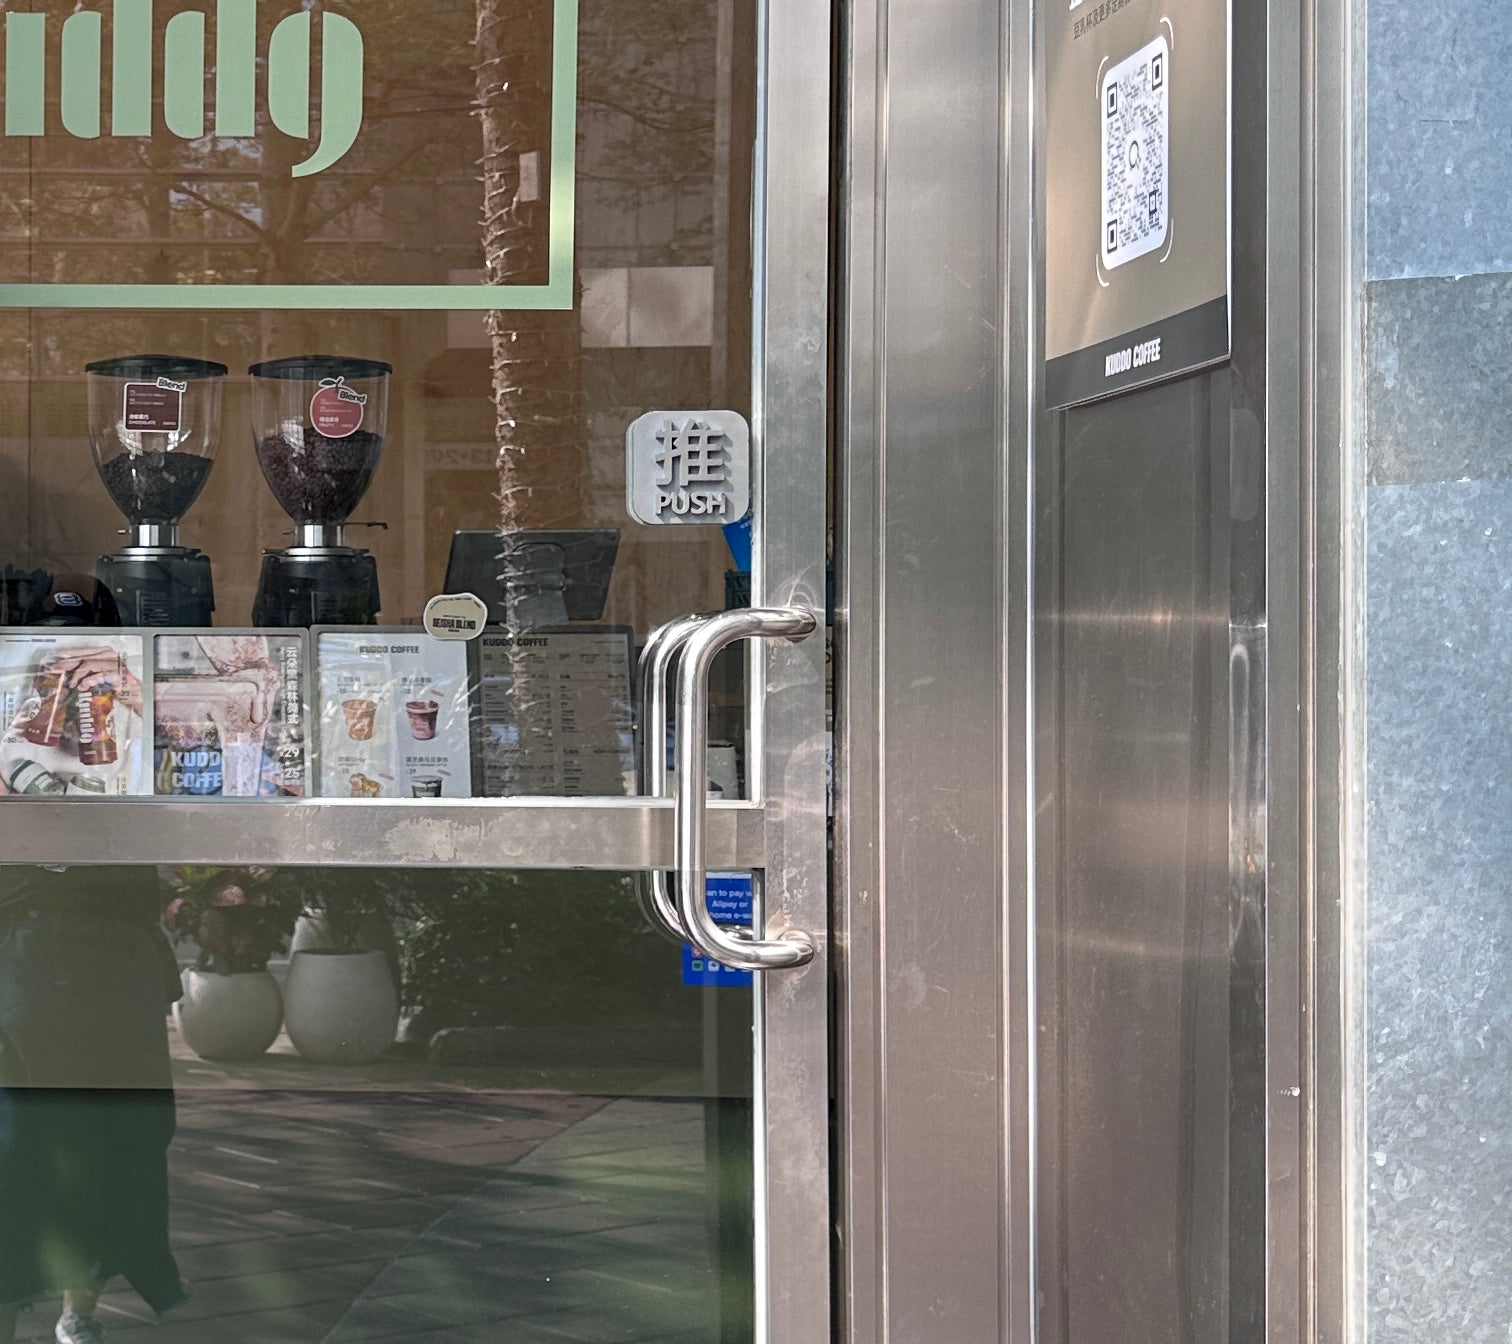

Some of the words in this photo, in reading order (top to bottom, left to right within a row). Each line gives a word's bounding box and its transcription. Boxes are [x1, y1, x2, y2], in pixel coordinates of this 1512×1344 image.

[1105, 348, 1132, 377] KUDDO
[1133, 337, 1161, 368] COFFEE
[655, 418, 727, 487] 推
[656, 492, 727, 516] PUSH
[390, 645, 420, 654] COFFEE
[516, 638, 549, 647] COFFEE
[170, 751, 222, 767] KUDD
[171, 771, 224, 788] COFFE
[718, 889, 728, 897] to
[728, 890, 744, 899] pay
[711, 899, 738, 910] Alipay
